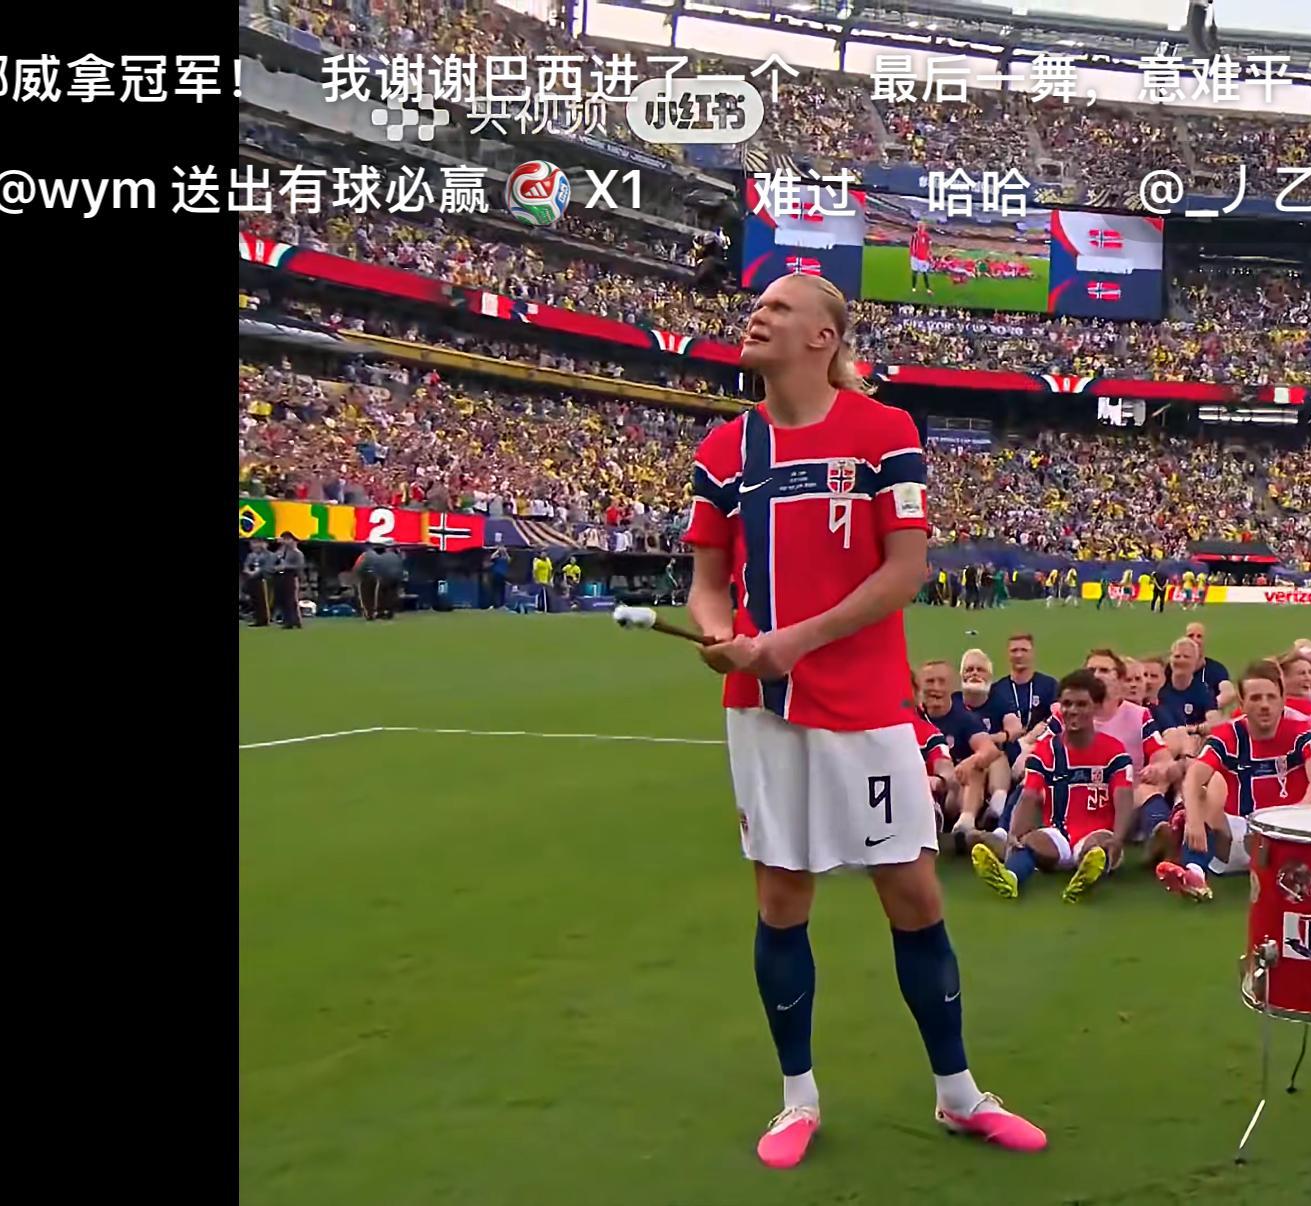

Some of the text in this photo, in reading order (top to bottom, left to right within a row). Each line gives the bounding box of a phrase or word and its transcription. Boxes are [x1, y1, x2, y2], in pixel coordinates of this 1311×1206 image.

[310, 503, 396, 544] 1 2
[829, 498, 852, 549] 9
[867, 775, 893, 824] 9
